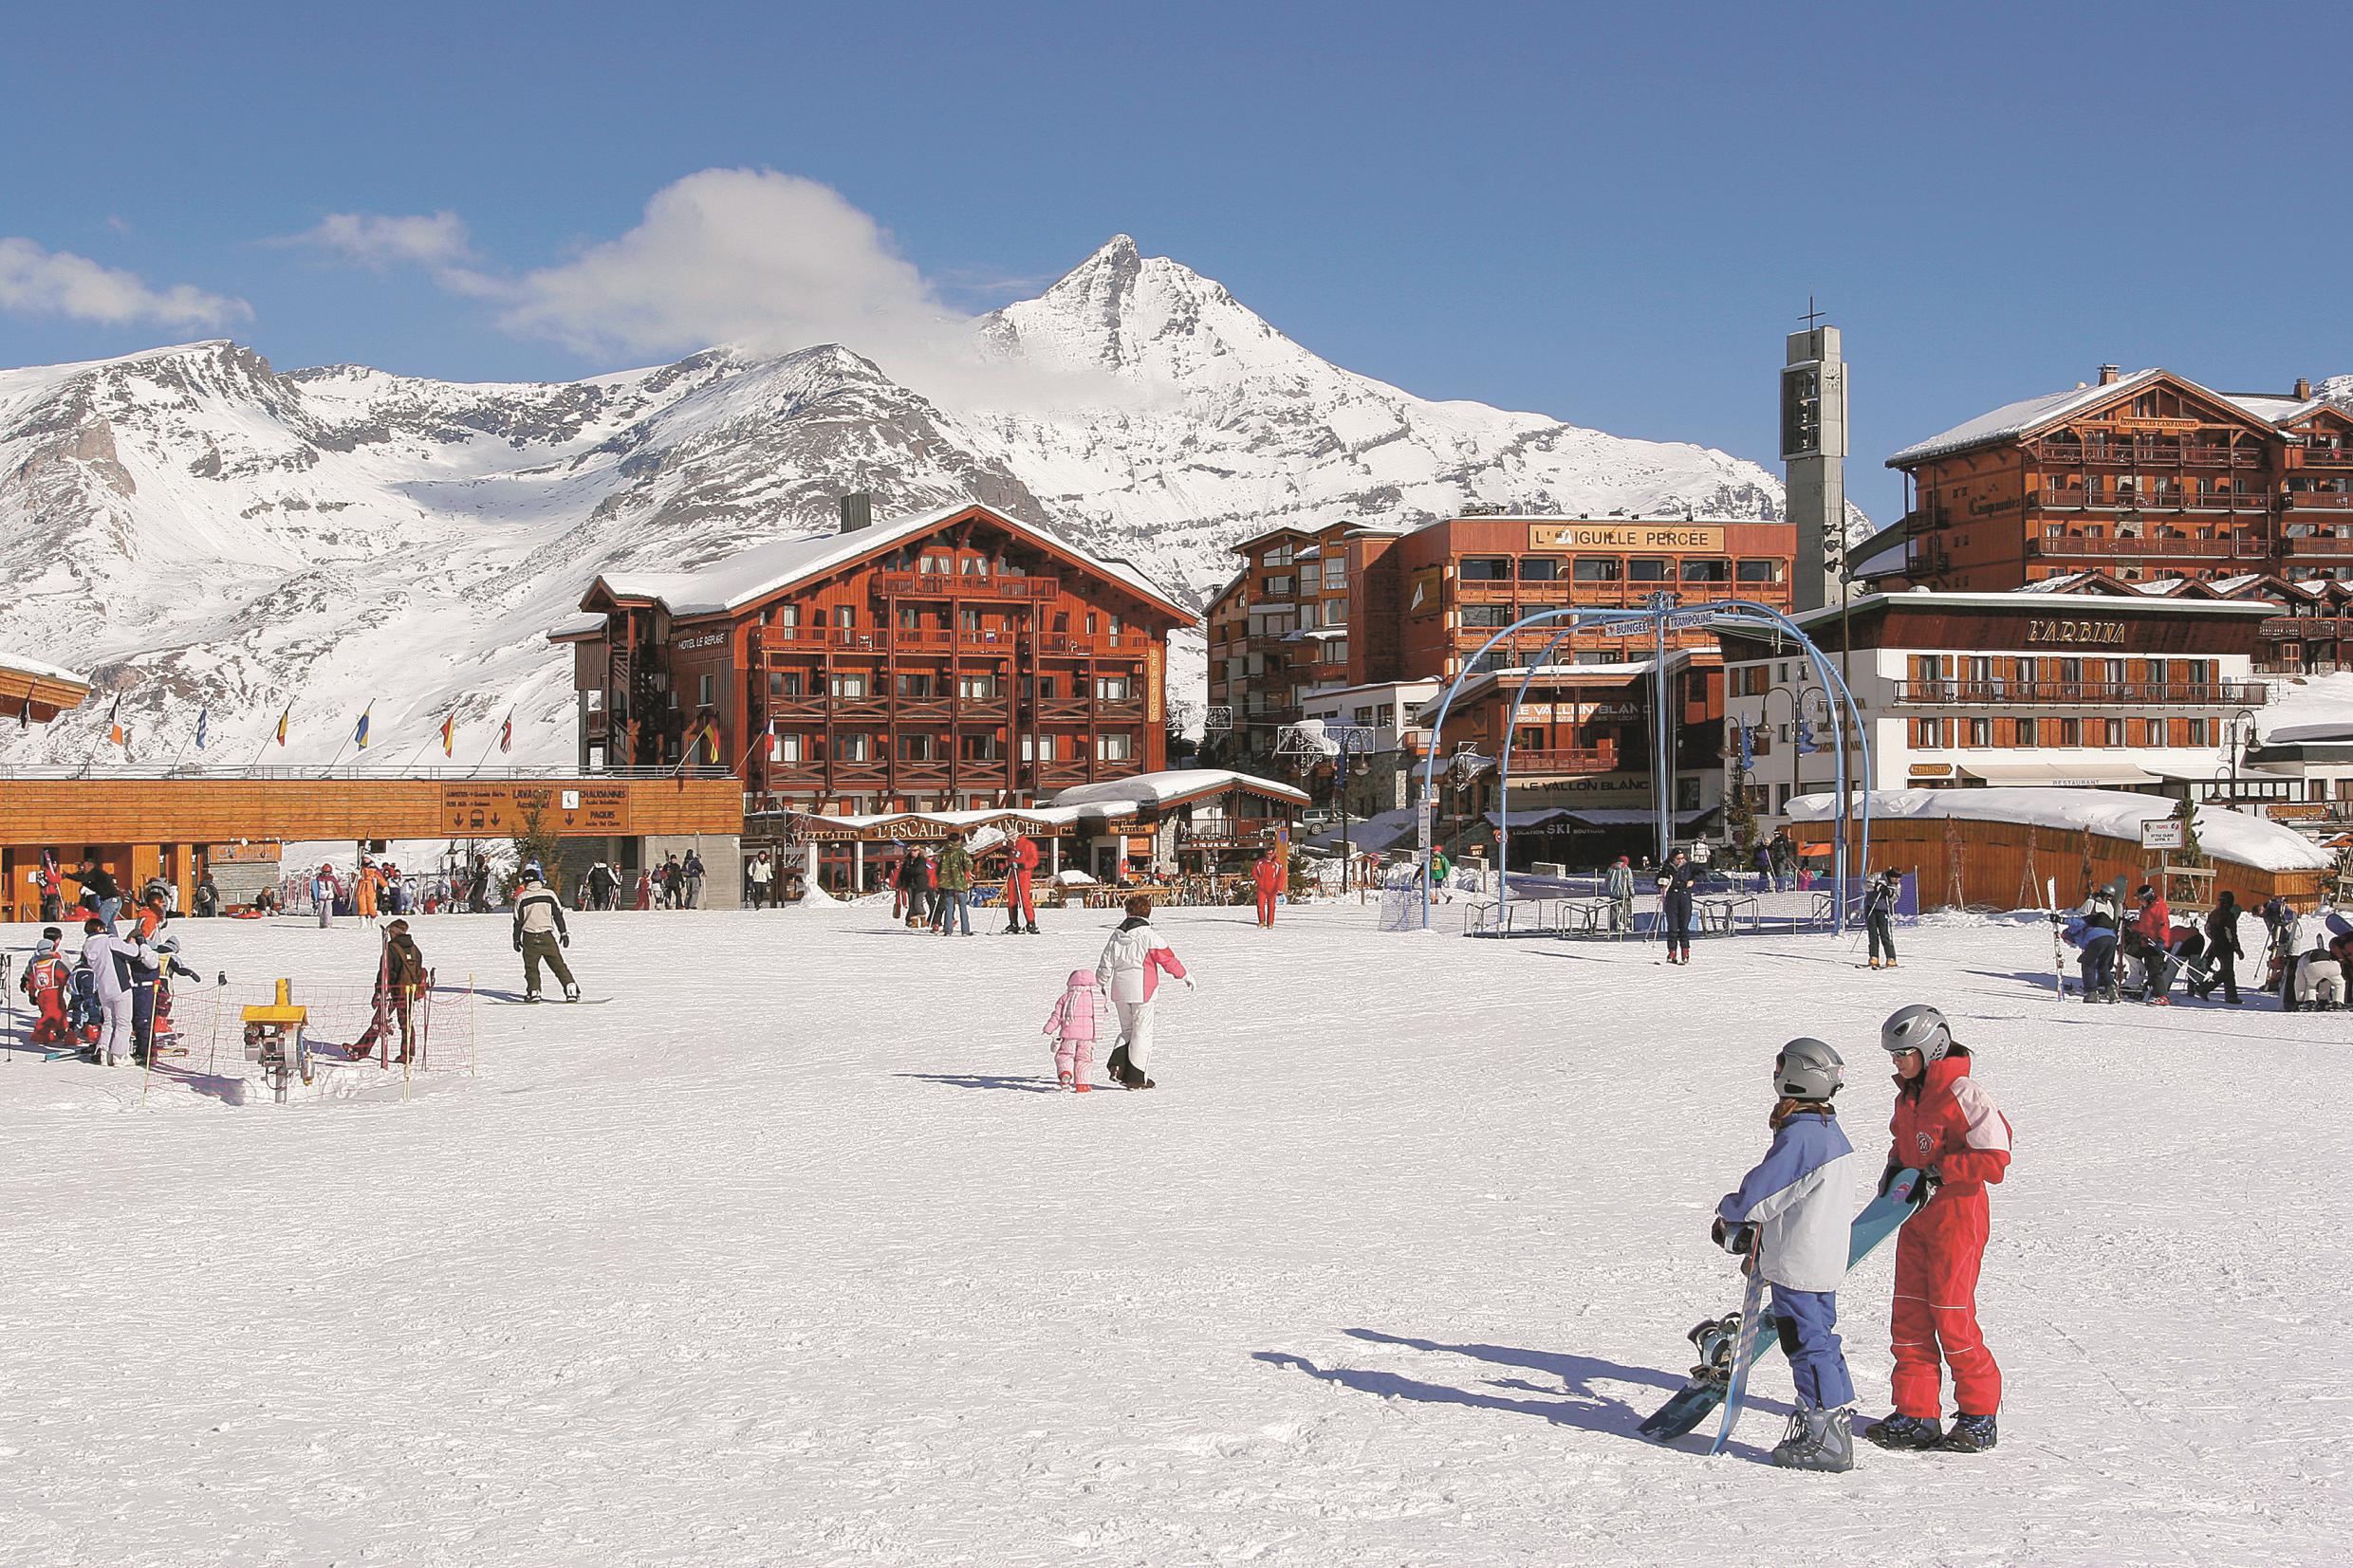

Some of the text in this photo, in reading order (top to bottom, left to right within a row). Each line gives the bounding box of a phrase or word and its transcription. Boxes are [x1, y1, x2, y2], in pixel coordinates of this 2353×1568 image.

[1646, 529, 1709, 545] PERCÉE
[1616, 621, 1648, 634] BUNGEE
[1670, 612, 1713, 628] TRAMPOLINE
[678, 633, 725, 650] HOTEL LE REFUGE
[1151, 649, 1158, 666] LE
[1521, 777, 1649, 793] LE VALLON BLANC
[877, 820, 948, 839] L'ESCALE
[1547, 822, 1571, 835] SKI
